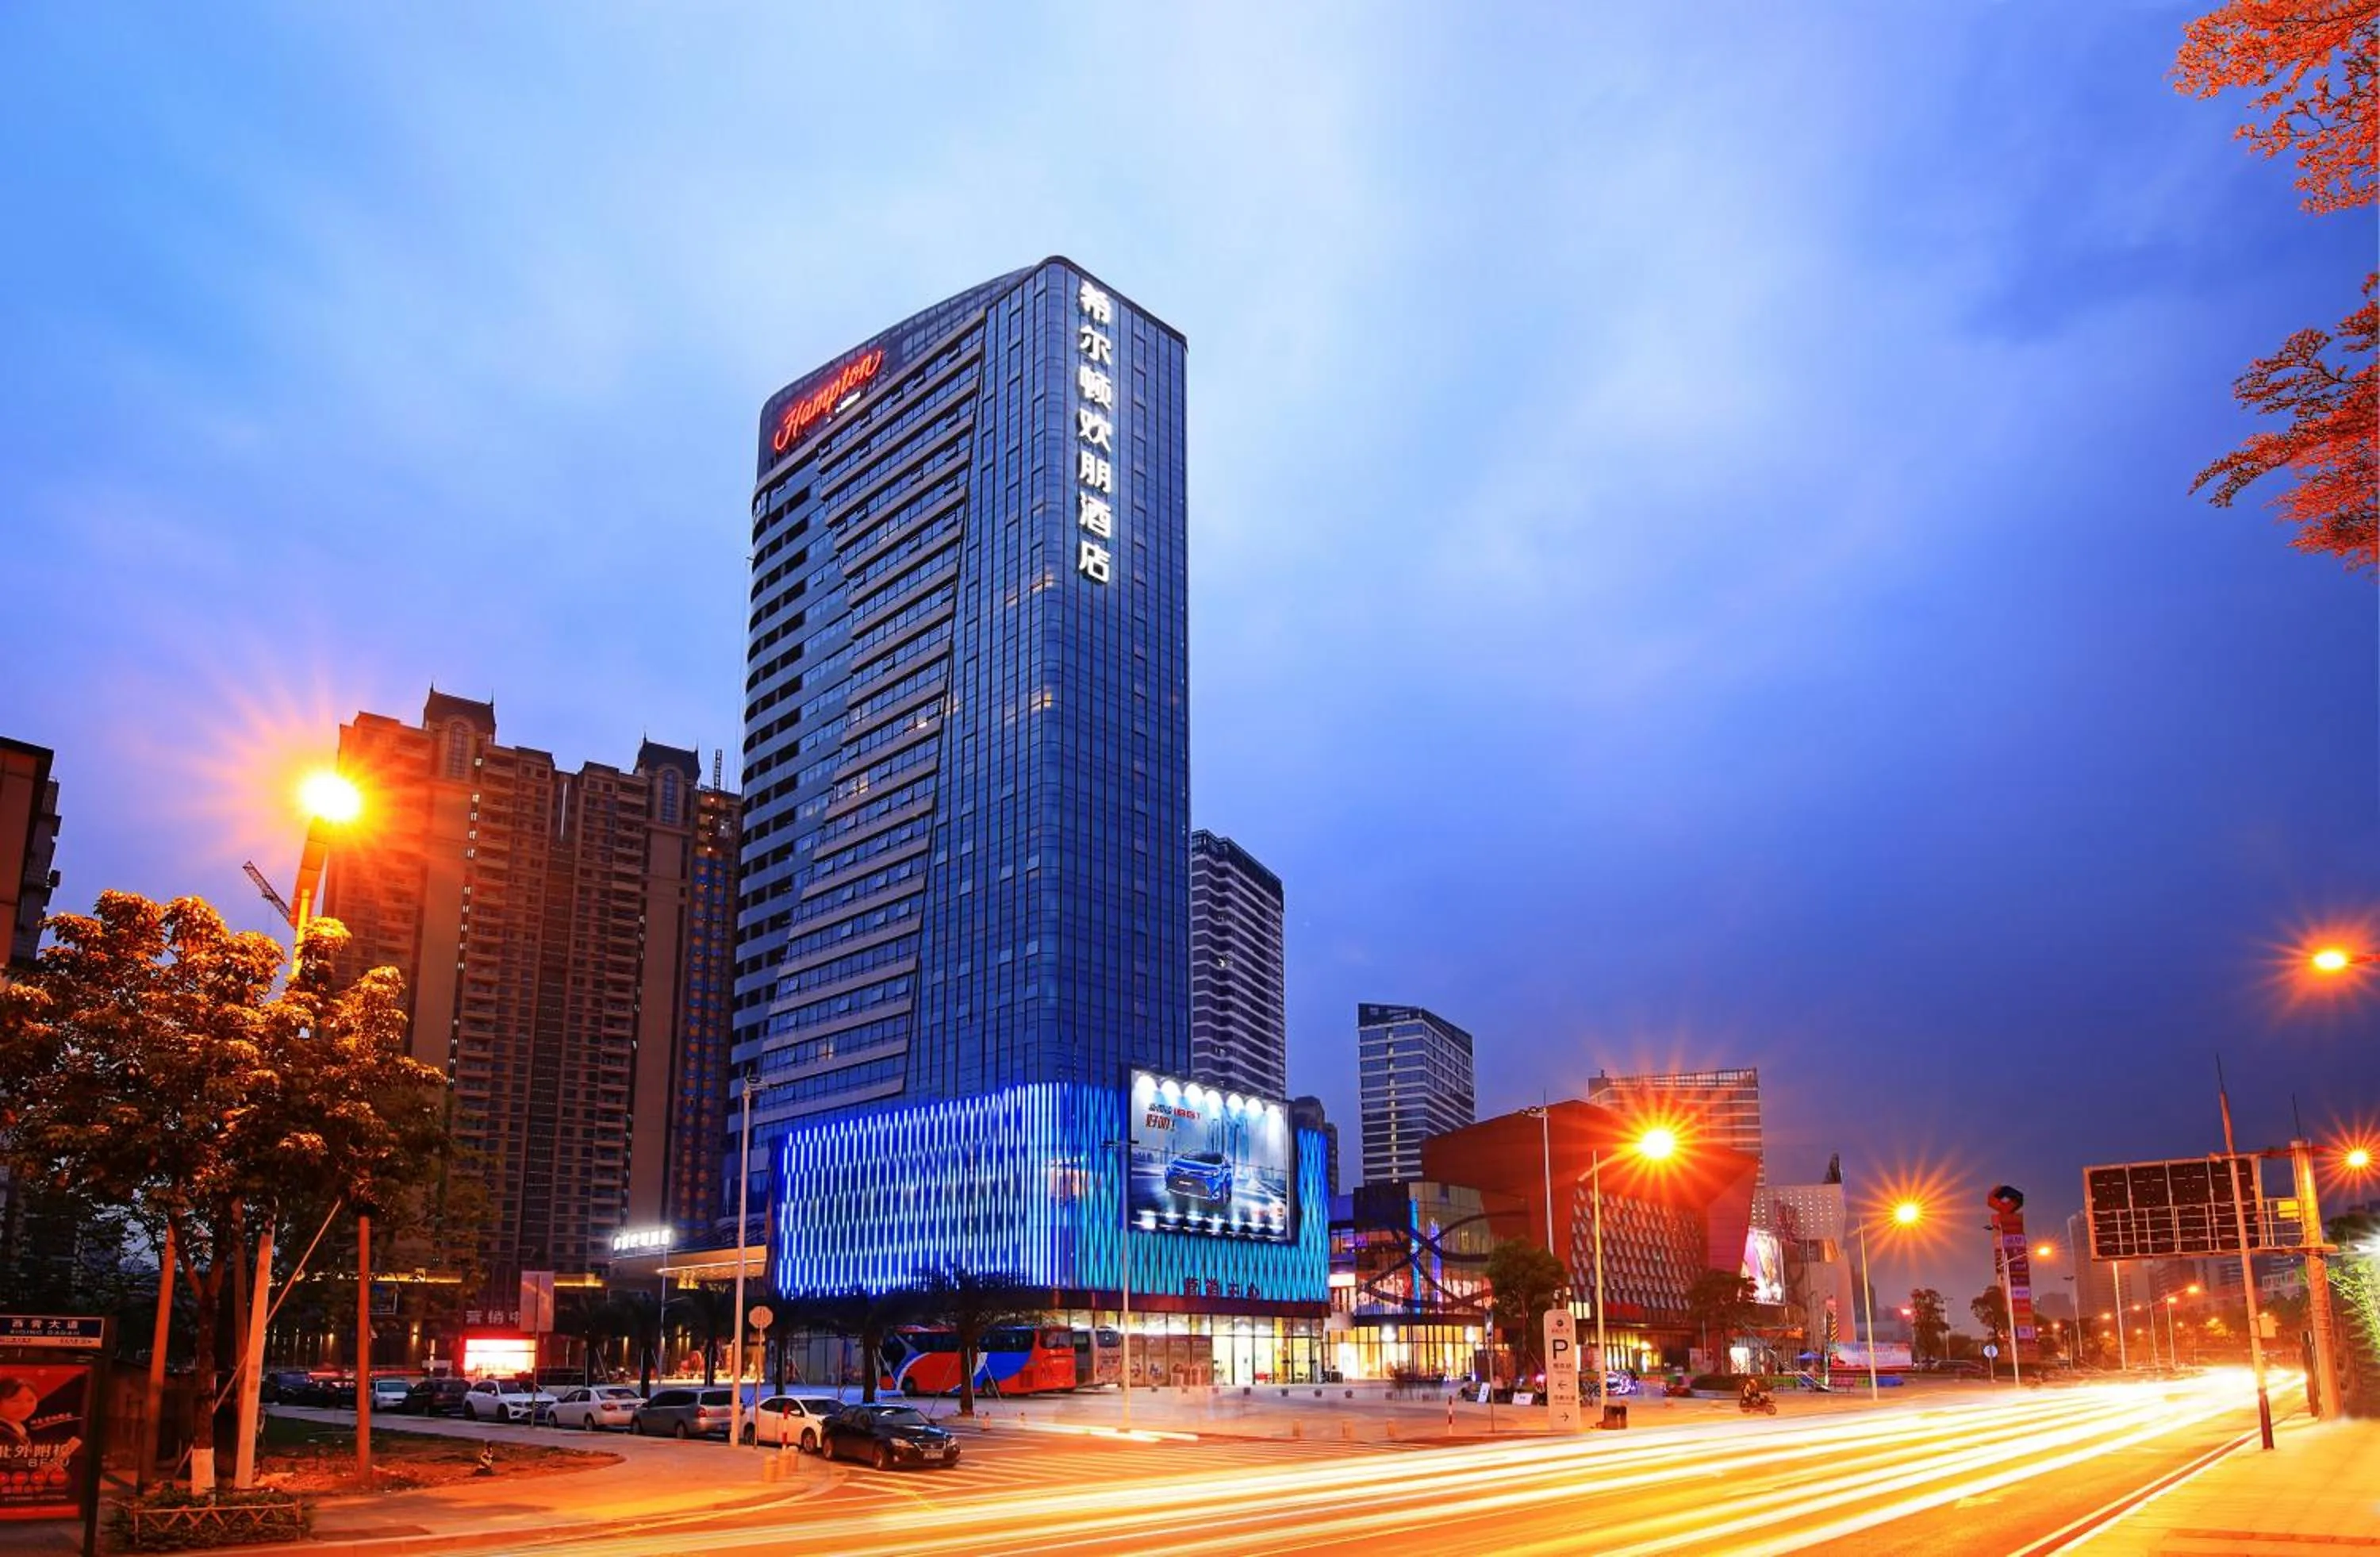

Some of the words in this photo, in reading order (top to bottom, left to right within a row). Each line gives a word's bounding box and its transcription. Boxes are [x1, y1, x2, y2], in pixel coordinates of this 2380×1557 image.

[774, 349, 882, 451] Hampton
[1078, 280, 1111, 582] 希尔顿欢朋酒店
[1553, 1339, 1568, 1359] P
